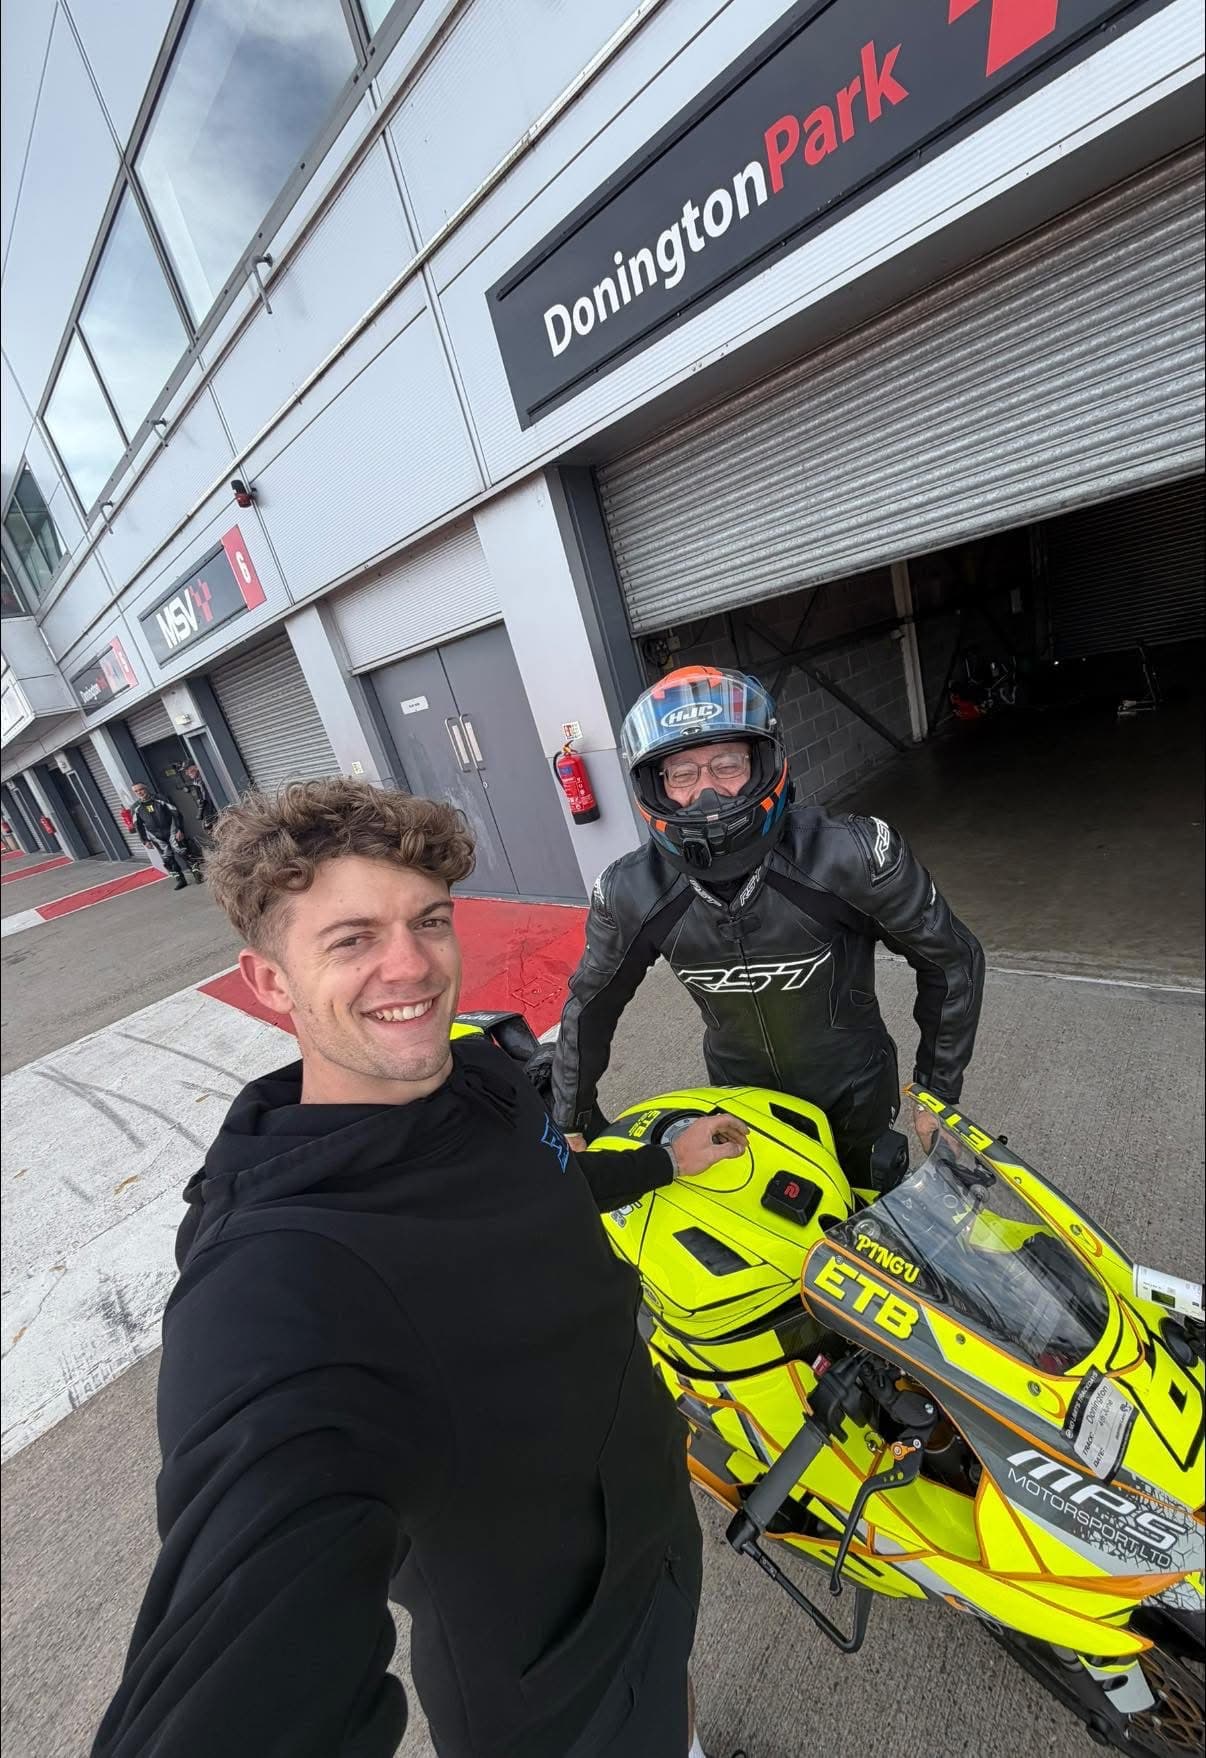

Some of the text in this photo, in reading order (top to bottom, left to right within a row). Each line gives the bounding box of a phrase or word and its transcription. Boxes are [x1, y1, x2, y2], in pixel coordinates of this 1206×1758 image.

[544, 39, 909, 357] DoningtonPark
[235, 551, 251, 584] 6
[155, 587, 198, 649] MSV
[668, 705, 713, 724] HJC
[678, 951, 831, 993] RST
[855, 1233, 920, 1283] PINGU
[813, 1256, 919, 1340] ETB
[1086, 1385, 1108, 1425] Donington
[1093, 1447, 1105, 1468] DATE:
[1007, 1467, 1172, 1568] MOTORSPORT LTD
